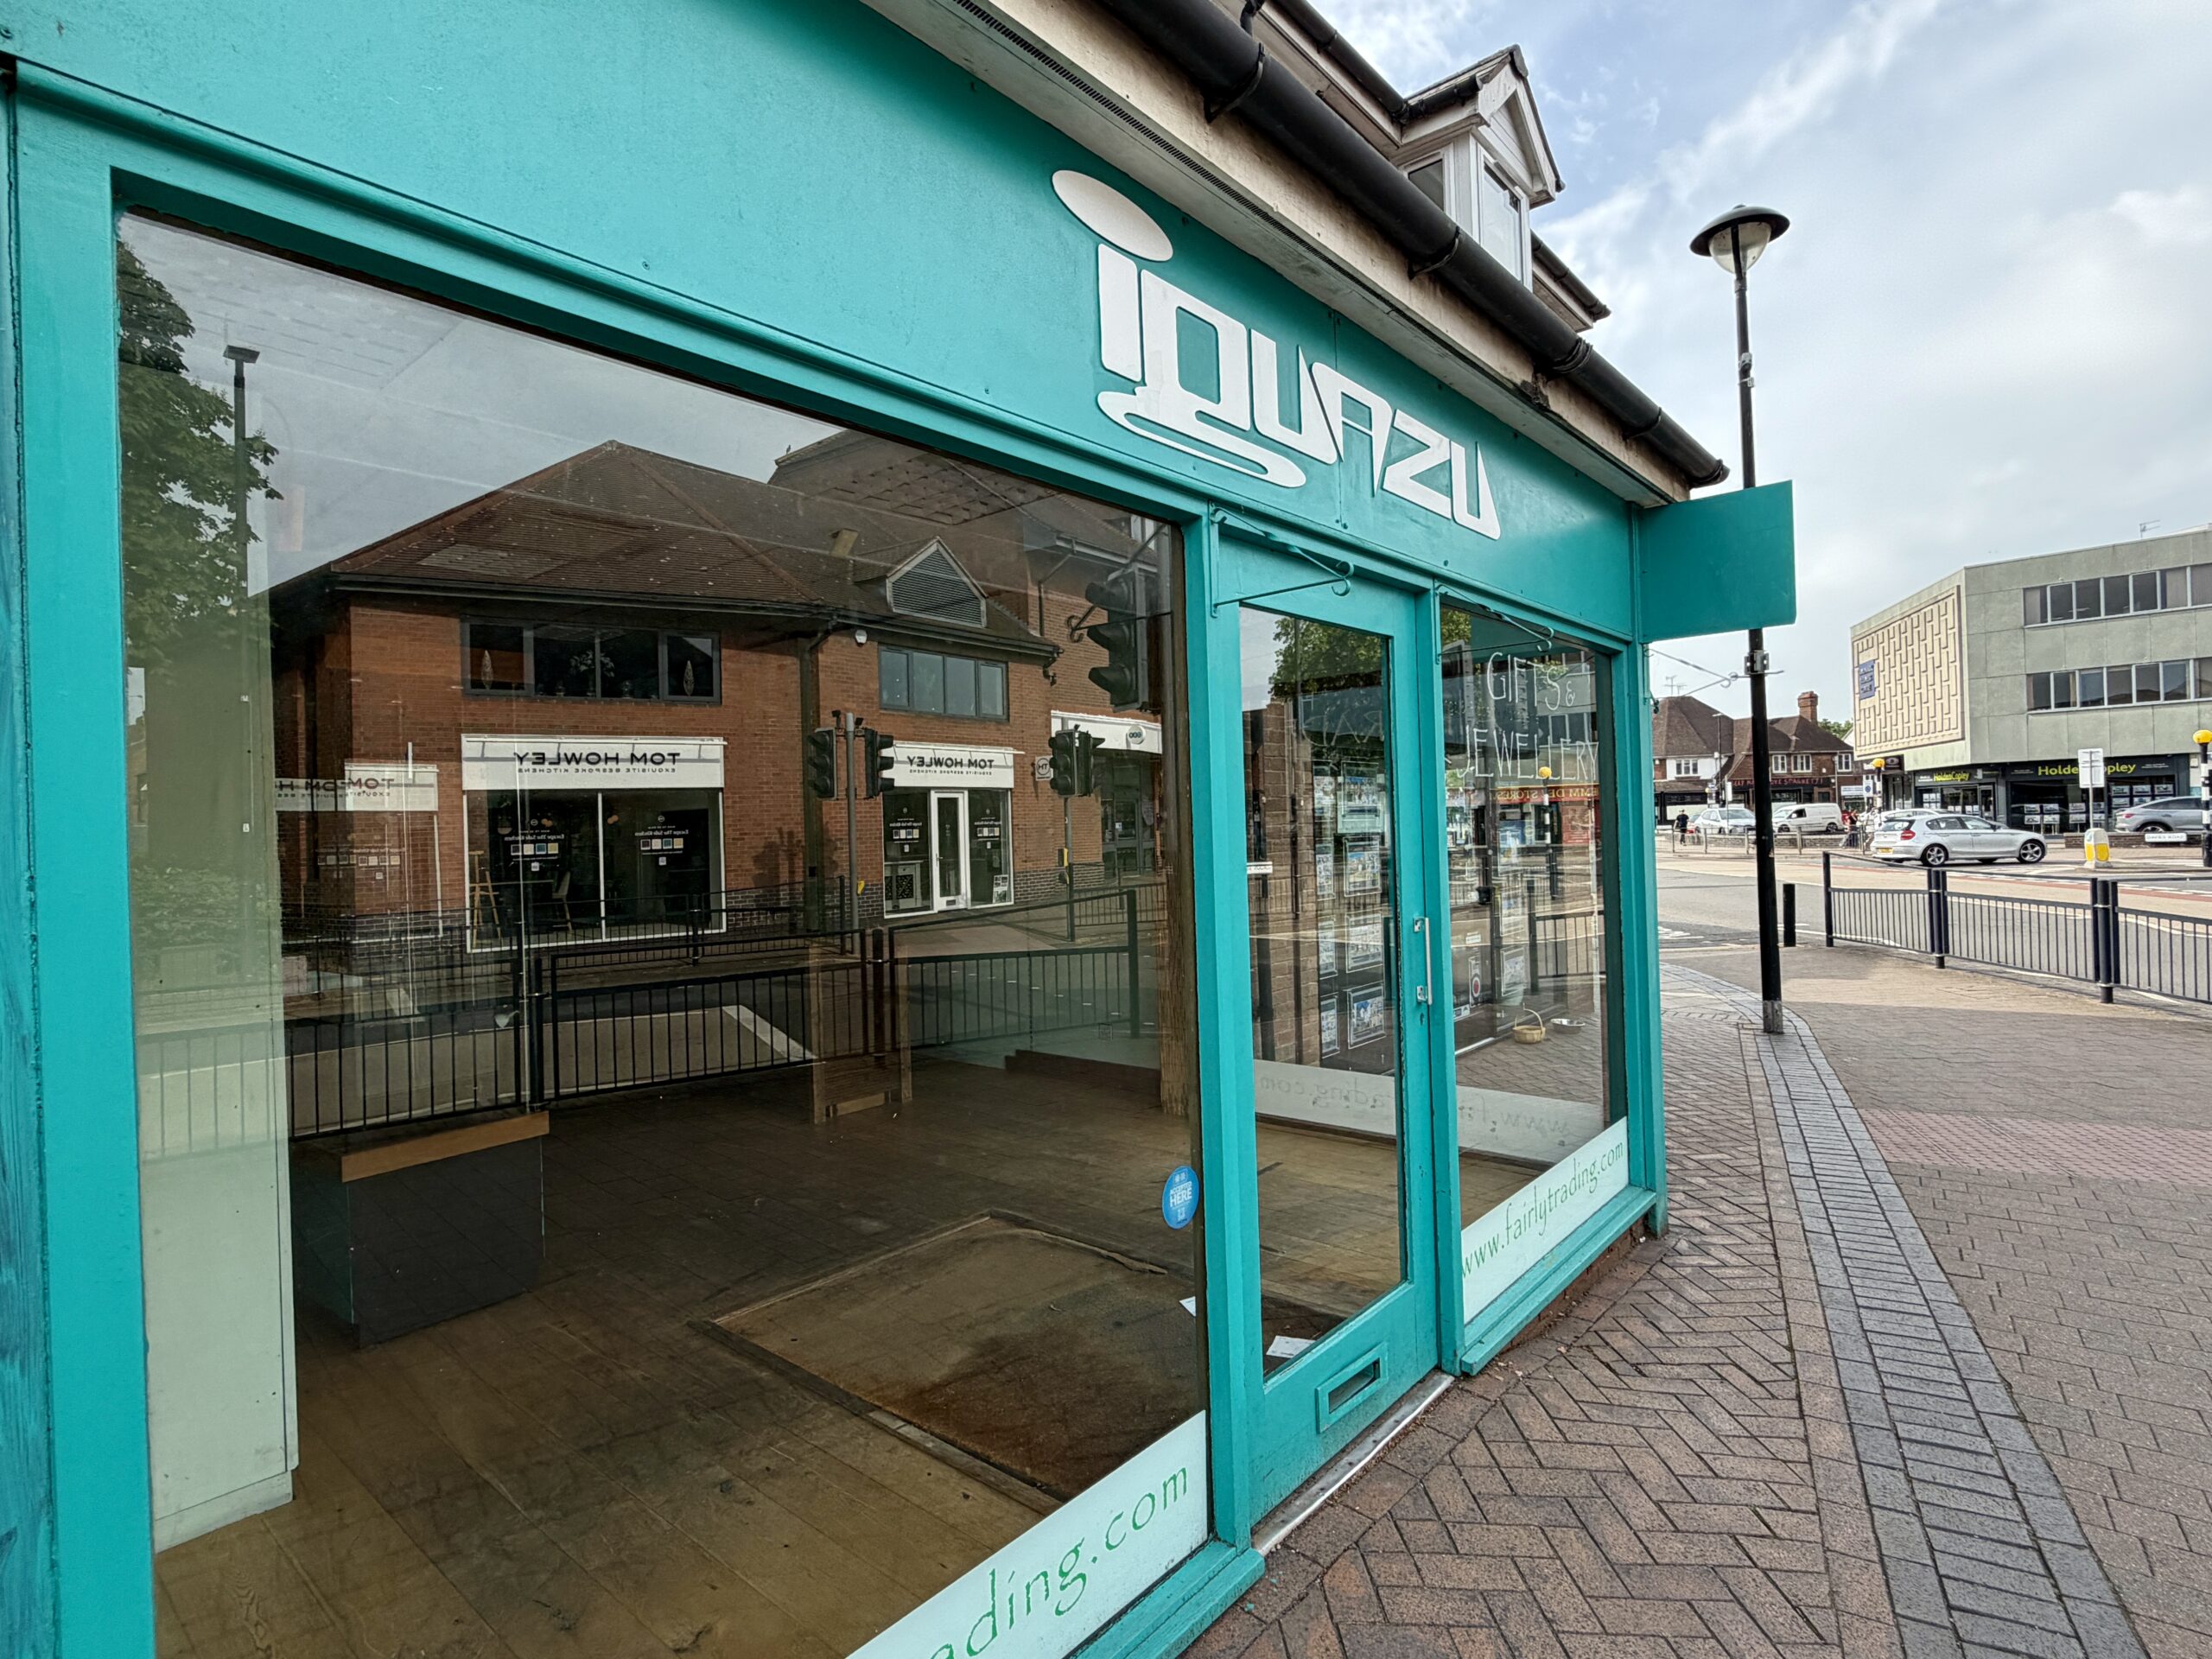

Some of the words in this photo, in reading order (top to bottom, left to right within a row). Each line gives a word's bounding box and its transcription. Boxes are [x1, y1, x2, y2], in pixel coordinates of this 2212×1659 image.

[1486, 652, 1561, 711] GIFTS
[1456, 724, 1599, 780] JEWELLERY
[2037, 762, 2136, 777] Holdepley
[1170, 1187, 1192, 1208] HERE
[1461, 1138, 1624, 1280] www.fairlytrading.com
